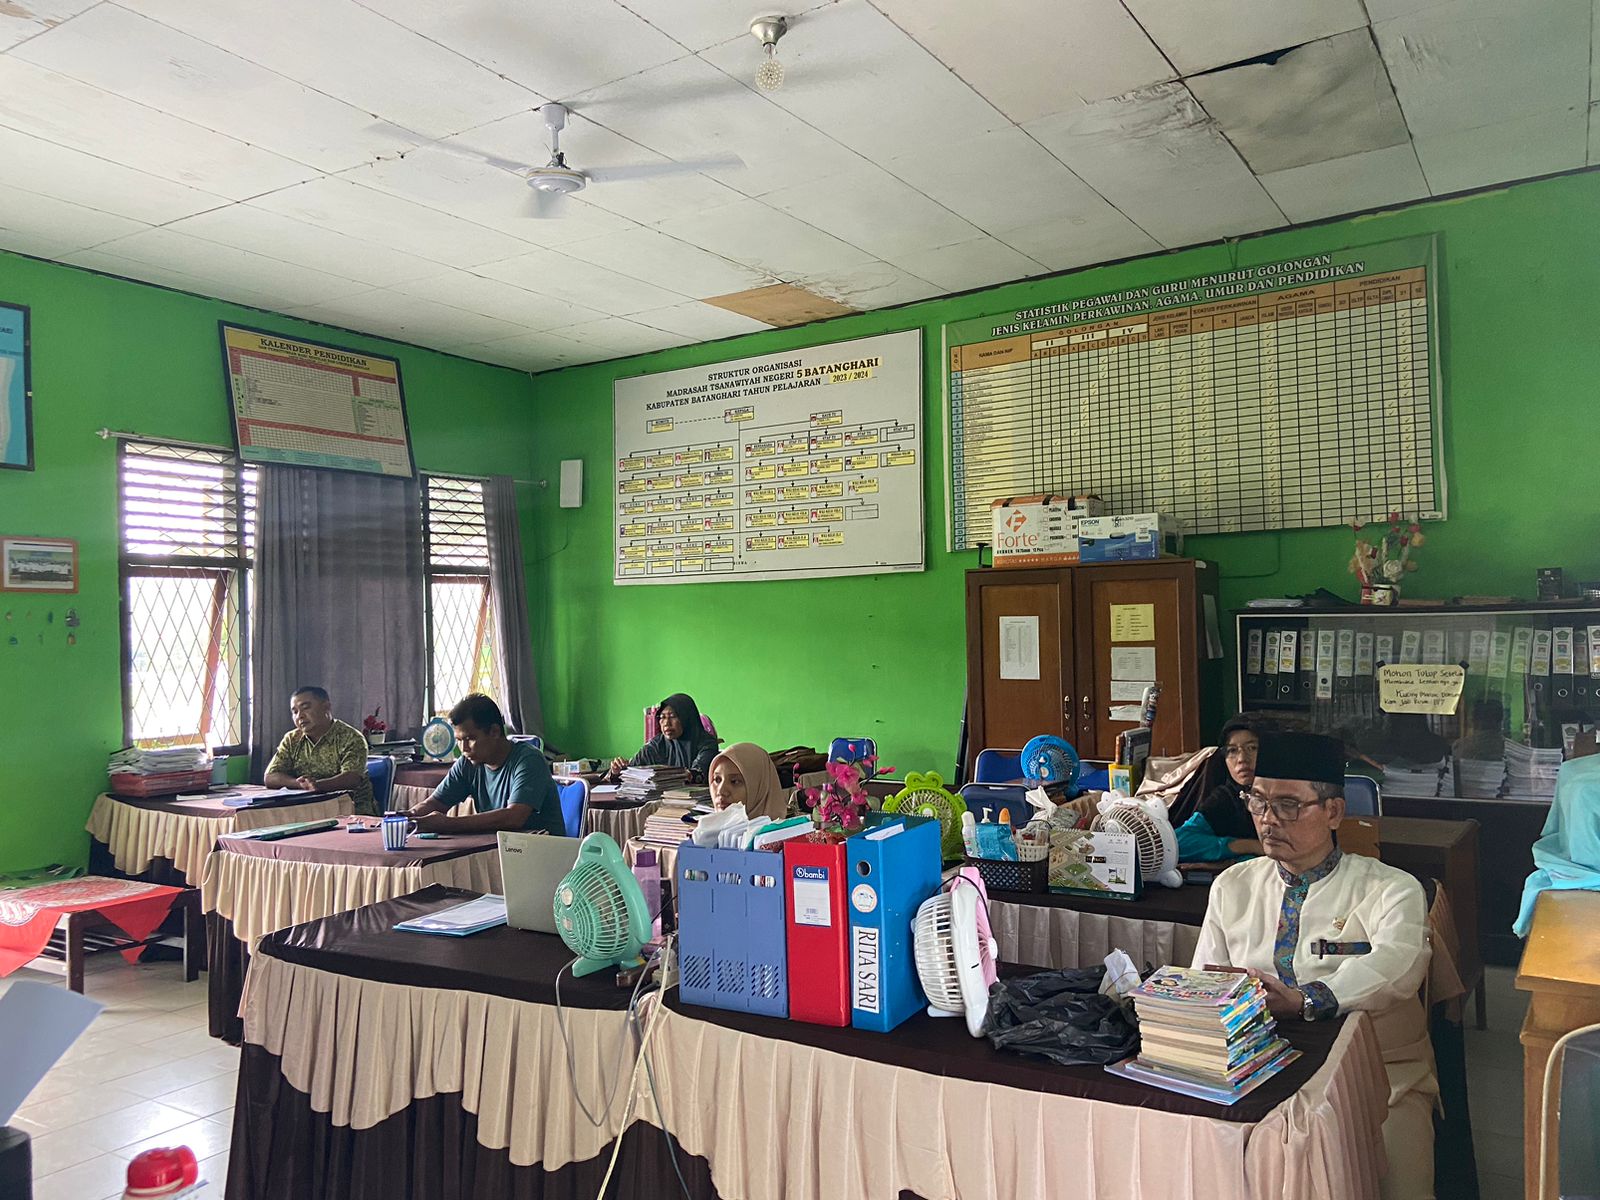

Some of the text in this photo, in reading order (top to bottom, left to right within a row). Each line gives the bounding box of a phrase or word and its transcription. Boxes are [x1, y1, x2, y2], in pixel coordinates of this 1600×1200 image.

[992, 324, 1020, 337] JENIS
[1022, 314, 1070, 331] KELAMIN
[1205, 284, 1244, 299] UMUR
[1248, 277, 1274, 291] DAN
[1278, 262, 1365, 286] PENDIDIKAN
[1015, 254, 1331, 320] STATISTIK PEGAWAI DAN GURU MENURUT GOLONGAN
[1277, 289, 1315, 300] AGAMA
[260, 338, 312, 356] KALENDER
[314, 349, 367, 366] PENDIDIKAN
[708, 360, 802, 381] STRUKTUR ORGANISASI
[646, 398, 689, 410] KABUPATEN
[691, 390, 740, 404] BATANGHARI
[743, 386, 770, 396] TAHUN
[772, 378, 821, 392] PELAJARAN
[832, 373, 847, 382] 2023
[853, 370, 868, 380] 2024
[666, 358, 879, 398] MADRASAH TSANAWIYAH NEGERI 5 BATANGHARI
[997, 532, 1038, 548] Forte
[804, 868, 825, 879] bambi
[859, 929, 877, 966] RITA
[859, 971, 877, 1010] SARI
